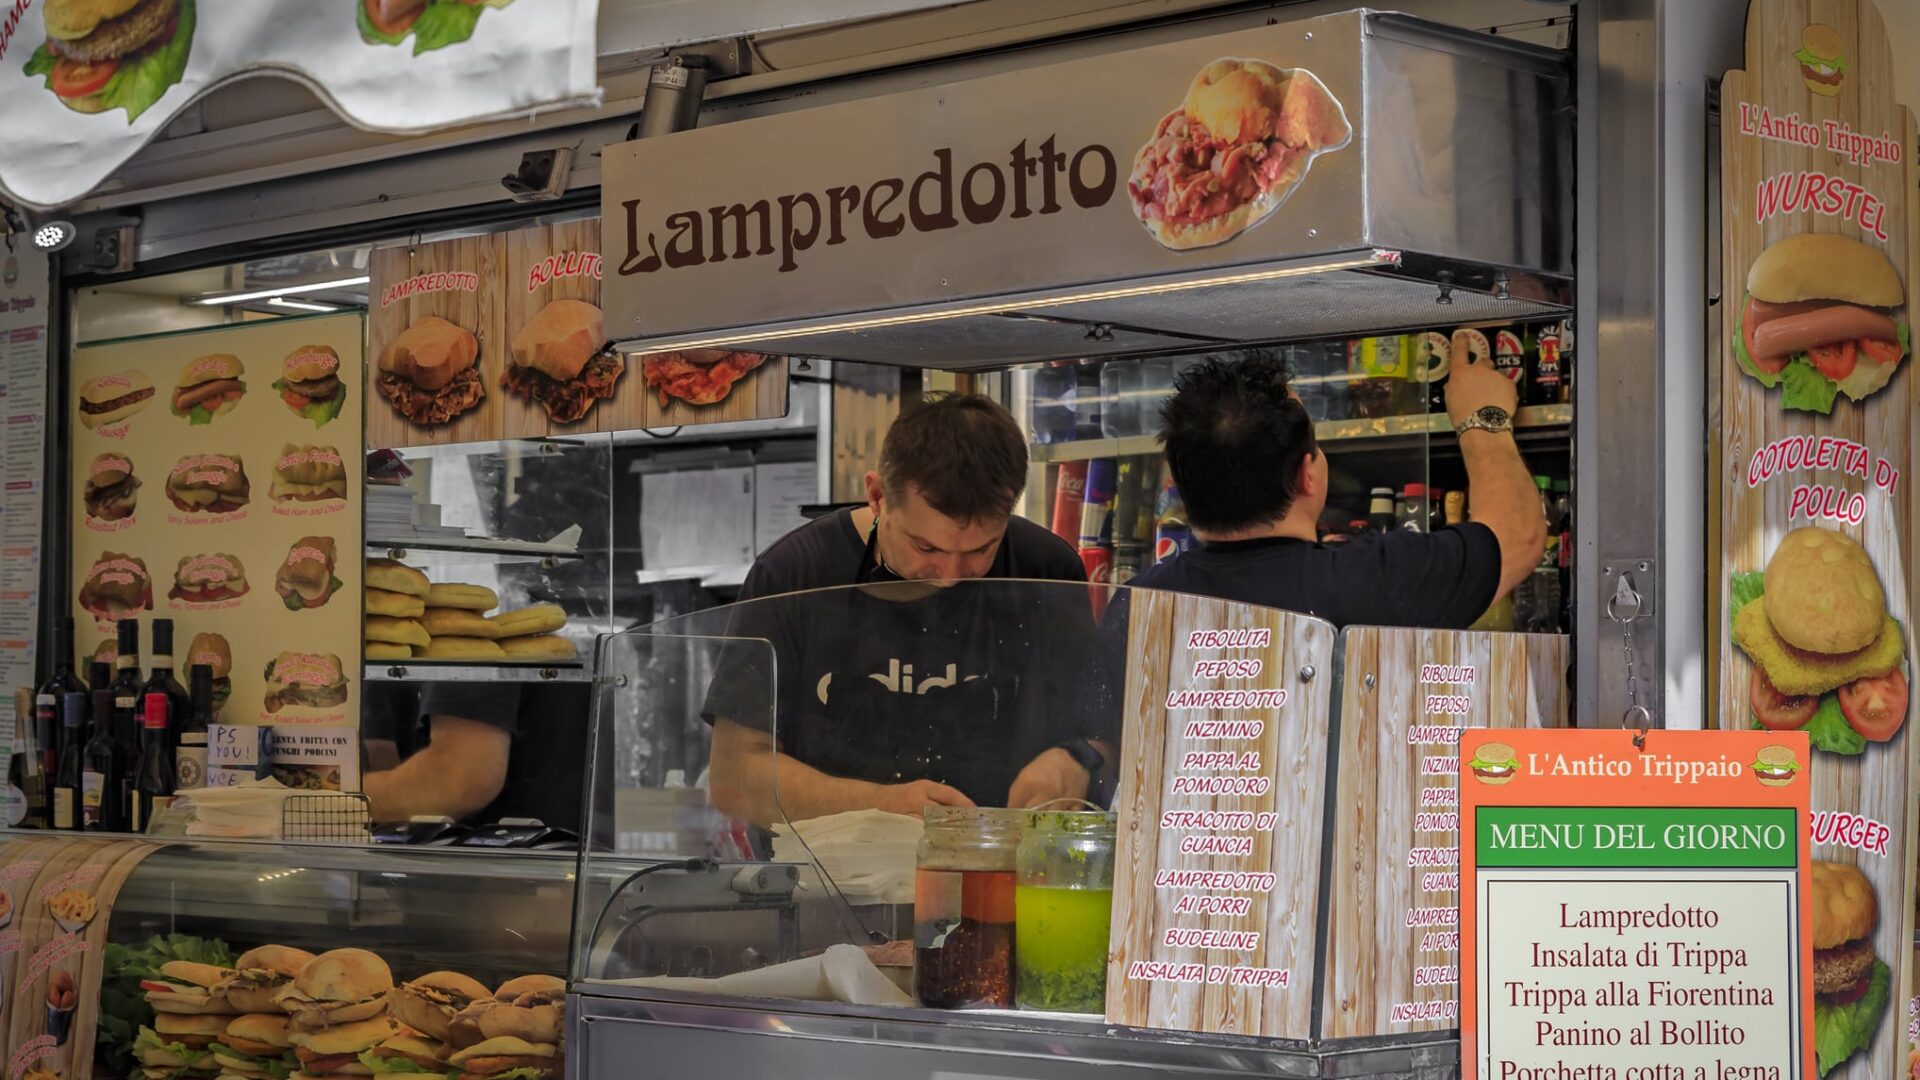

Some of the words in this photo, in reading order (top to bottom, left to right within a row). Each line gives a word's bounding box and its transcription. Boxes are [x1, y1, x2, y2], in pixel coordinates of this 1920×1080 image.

[1740, 102, 1820, 148] L'Antico
[1823, 119, 1900, 166] Trippaio
[618, 134, 1117, 276] Lampredotto
[1757, 172, 1887, 240] WURSTEL
[382, 272, 478, 307] LAMPREDOTTO
[1748, 436, 1869, 487] COTOLETTA
[1875, 459, 1899, 495] DI
[1789, 486, 1866, 523] POLLO
[1188, 629, 1270, 648] RIBOLLITA
[1194, 660, 1261, 678] PEPOSO
[1421, 665, 1475, 683] RIBOLLITA
[1167, 690, 1286, 708] LAMPREDOTTO
[1426, 696, 1470, 713] PEPOSO
[1185, 721, 1263, 738] INZIMINO
[332, 737, 348, 746] CON
[304, 747, 338, 758] PORCINI
[1183, 752, 1235, 769] PAPPA
[1237, 752, 1260, 769] AL
[1528, 753, 1632, 777] L'Antico
[1638, 754, 1743, 784] Trippaio
[1172, 777, 1269, 795] POMODORO
[1421, 788, 1456, 805] PAPPA
[1161, 811, 1253, 830] STRACOTTO
[1256, 813, 1277, 830] DI
[1415, 813, 1460, 831] POMOD
[1180, 836, 1252, 854] GUANCIA
[1489, 823, 1584, 850] MENU
[1593, 823, 1656, 850] DEL
[1663, 823, 1786, 850] GIORNO
[1155, 870, 1276, 891] LAMPREDOTTO
[1175, 896, 1196, 912] AI
[1198, 897, 1251, 915] PORRI
[1559, 902, 1719, 936] Lampredotto
[1165, 929, 1258, 949] BUDELLINE
[1420, 933, 1434, 951] AI
[1530, 941, 1629, 968] Insalata
[1635, 941, 1659, 967] di
[1666, 942, 1748, 975] Trippa
[1129, 962, 1204, 982] INSALATA
[1208, 966, 1228, 982] DI
[1232, 968, 1289, 987] TRIPPA
[1504, 981, 1588, 1014] Trippa
[1595, 981, 1640, 1006] alla
[1648, 981, 1775, 1006] Fiorentina
[1391, 1003, 1442, 1021] INSALATA
[1444, 1001, 1459, 1018] DI
[1535, 1019, 1622, 1046] Panino
[1629, 1020, 1651, 1046] al
[1659, 1019, 1746, 1045] Bollito
[1499, 1059, 1617, 1080] Porchetta
[1625, 1063, 1685, 1080] cotta
